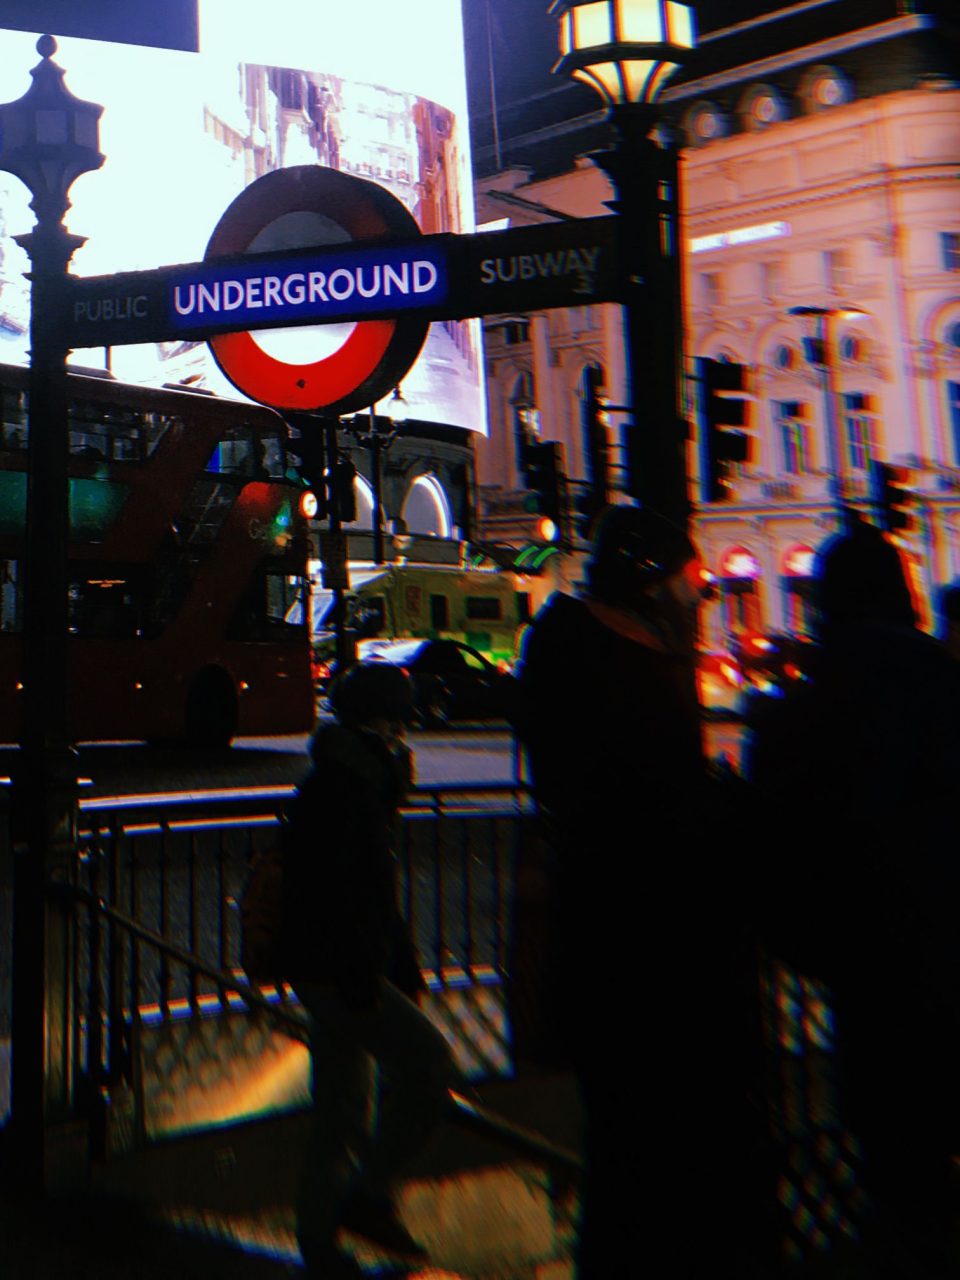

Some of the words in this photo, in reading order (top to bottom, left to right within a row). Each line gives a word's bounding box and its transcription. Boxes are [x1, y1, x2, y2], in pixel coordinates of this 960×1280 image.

[73, 295, 148, 322] PUBLIC
[173, 258, 438, 316] UNDERGROUND
[479, 246, 603, 285] SUBWAY
